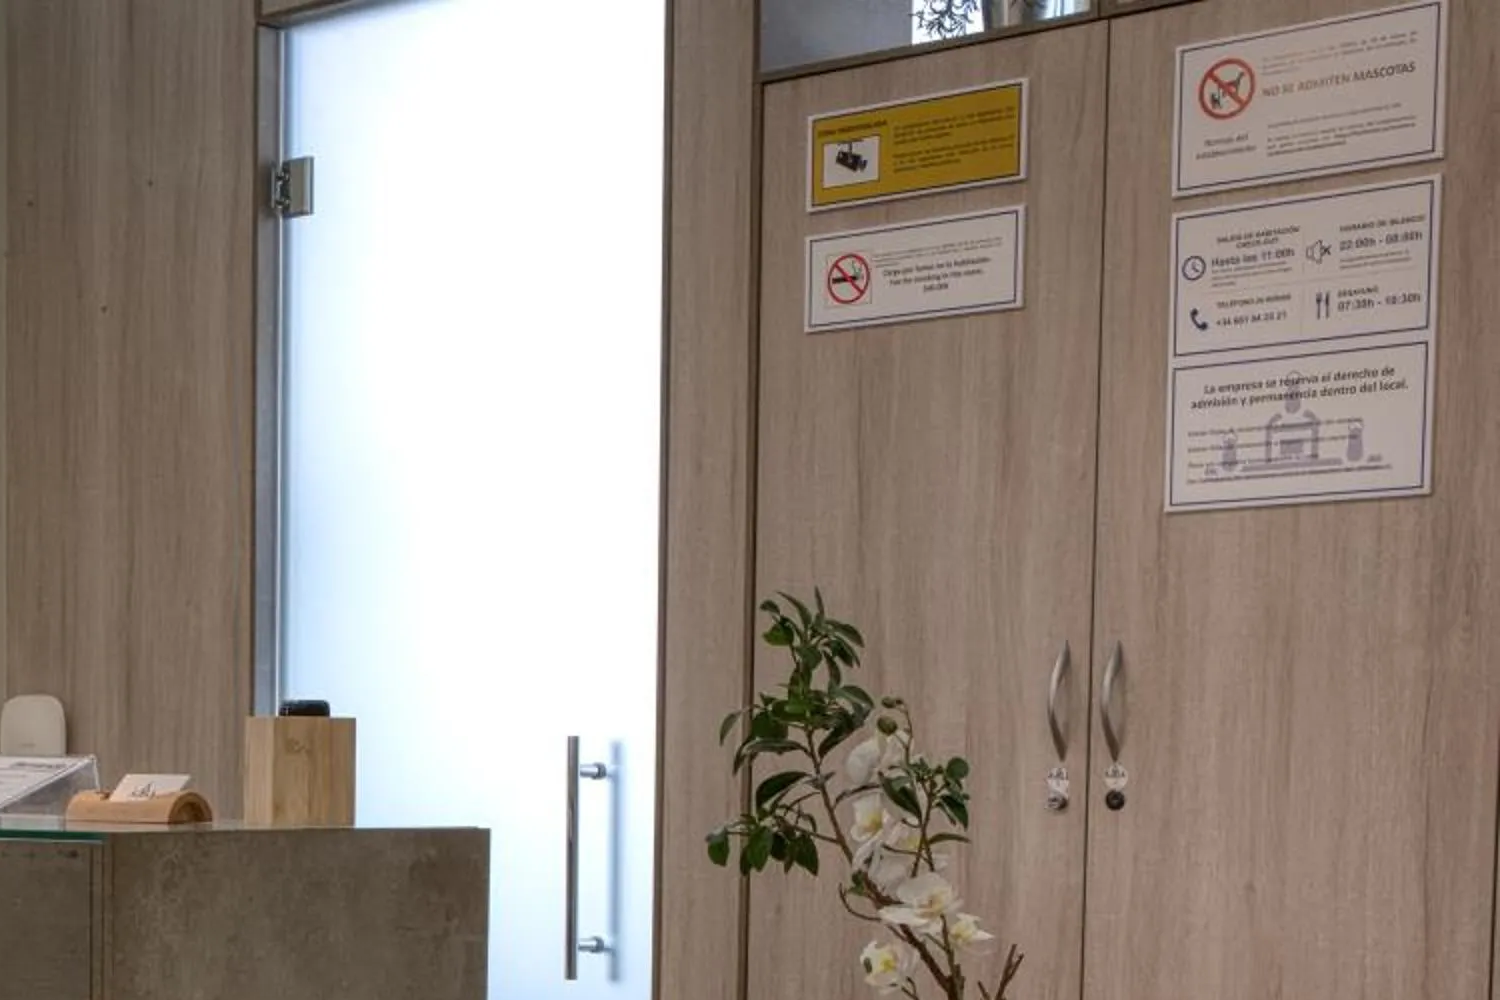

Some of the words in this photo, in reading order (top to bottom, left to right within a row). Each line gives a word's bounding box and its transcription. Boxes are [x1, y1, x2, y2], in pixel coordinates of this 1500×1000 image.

[1263, 86, 1279, 98] NO
[1282, 83, 1295, 95] SE
[1298, 73, 1351, 92] ADMITEN
[1353, 62, 1417, 82] MASCOTAS
[1211, 255, 1241, 267] Hasta
[1242, 253, 1258, 263] las
[1190, 395, 1238, 410] admisión
[1248, 387, 1318, 406] permanencia
[1319, 385, 1357, 398] dentro
[1359, 382, 1378, 393] del
[1379, 379, 1409, 392] local.
[1203, 383, 1216, 394] La
[1218, 380, 1263, 396] empresa
[1265, 378, 1277, 389] se
[1278, 374, 1319, 388] reserva
[1320, 372, 1332, 382] el
[1333, 367, 1380, 381] derecho
[1381, 365, 1395, 377] de
